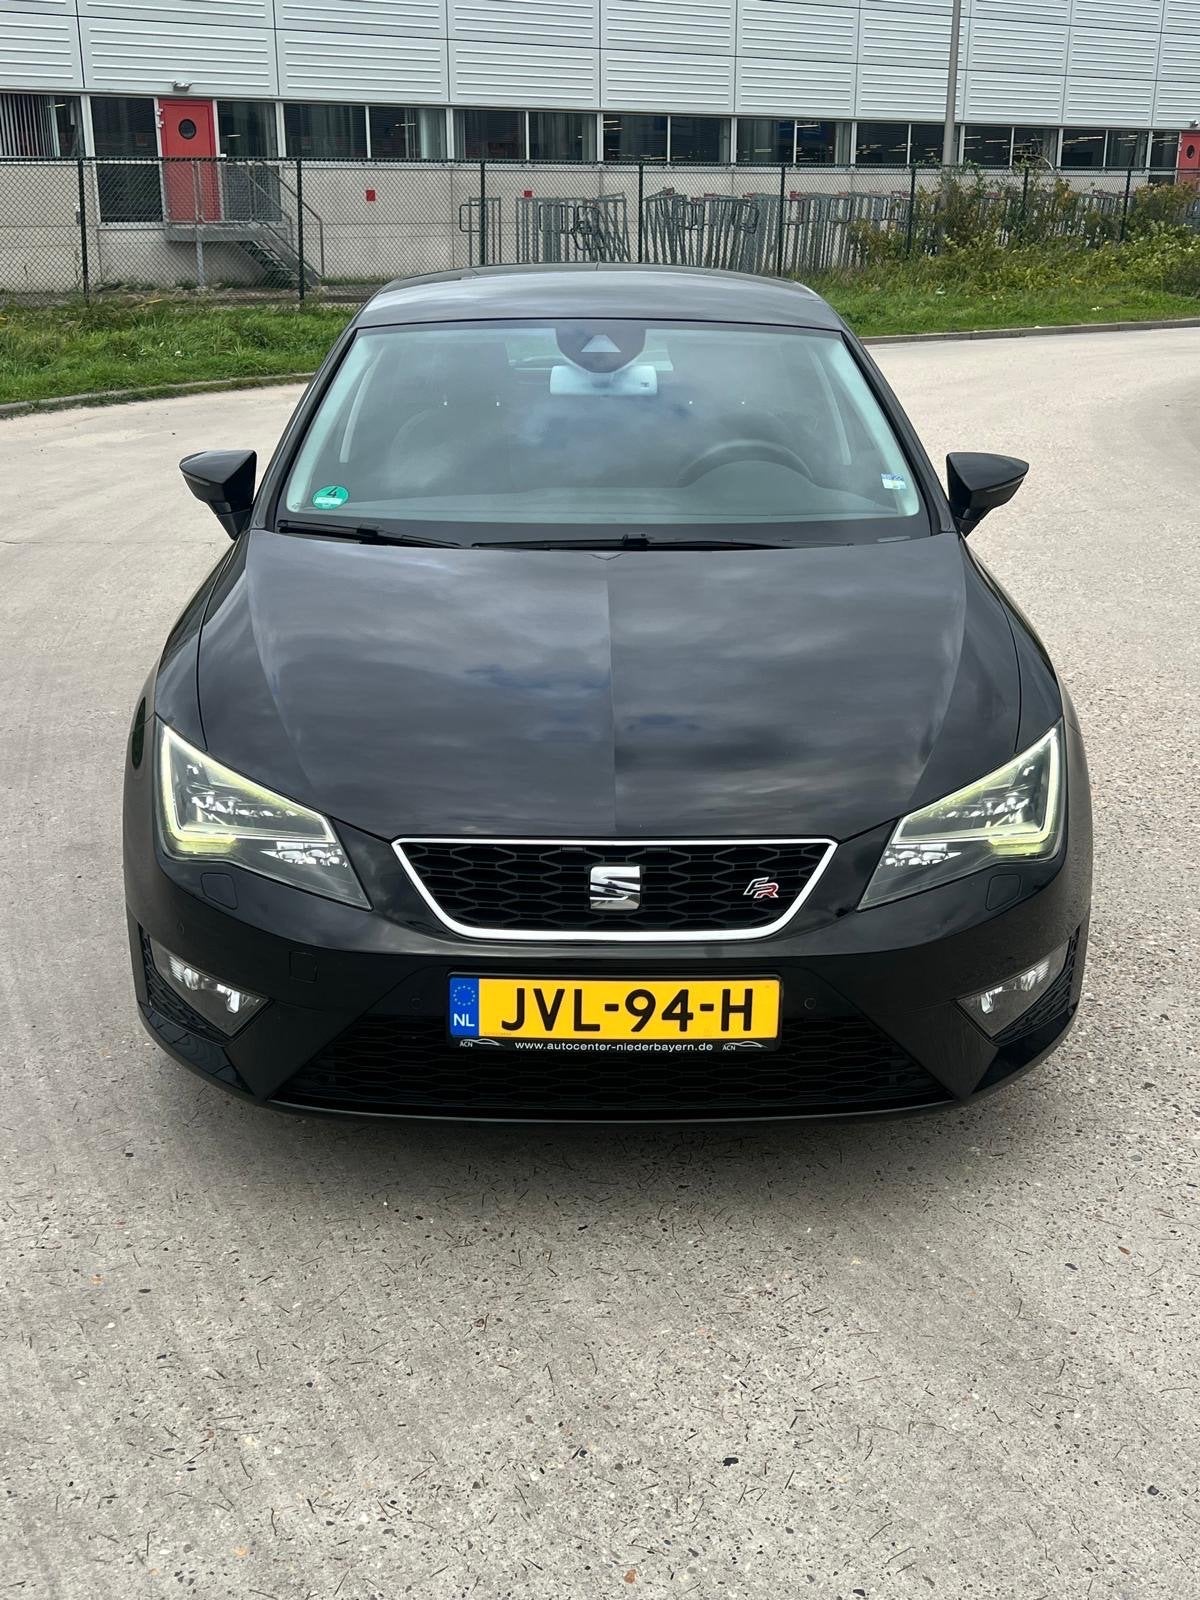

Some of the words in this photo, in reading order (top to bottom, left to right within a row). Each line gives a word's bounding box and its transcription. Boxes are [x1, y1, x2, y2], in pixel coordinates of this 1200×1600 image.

[743, 876, 779, 899] FR
[501, 988, 753, 1032] JVL-94-H
[453, 1013, 475, 1027] NL
[459, 1040, 473, 1048] ACN
[514, 1041, 713, 1052] www.autocenter-niederbayern.de
